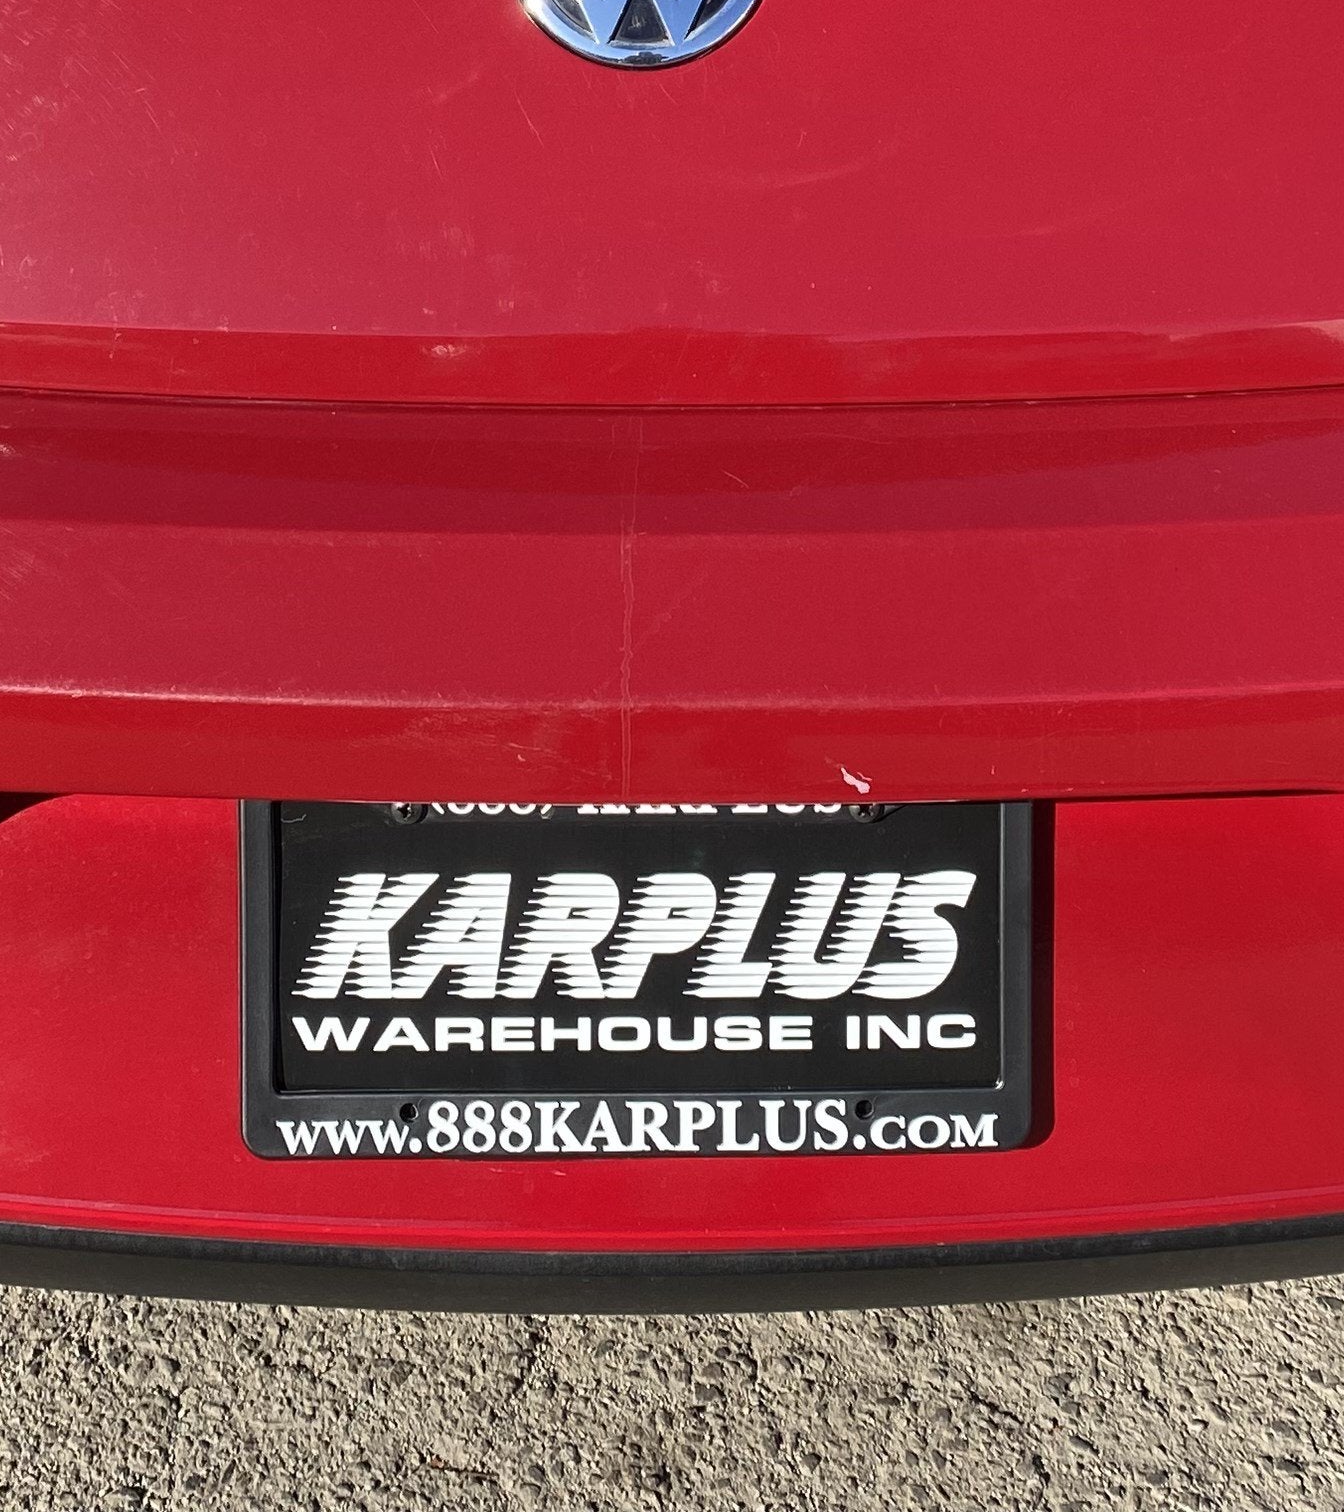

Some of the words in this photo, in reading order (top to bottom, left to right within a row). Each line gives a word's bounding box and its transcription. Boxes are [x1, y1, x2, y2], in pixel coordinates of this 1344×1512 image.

[290, 871, 978, 1001] KARPLUS
[292, 1015, 814, 1052] WAREHOUSE
[847, 1014, 978, 1051] INC
